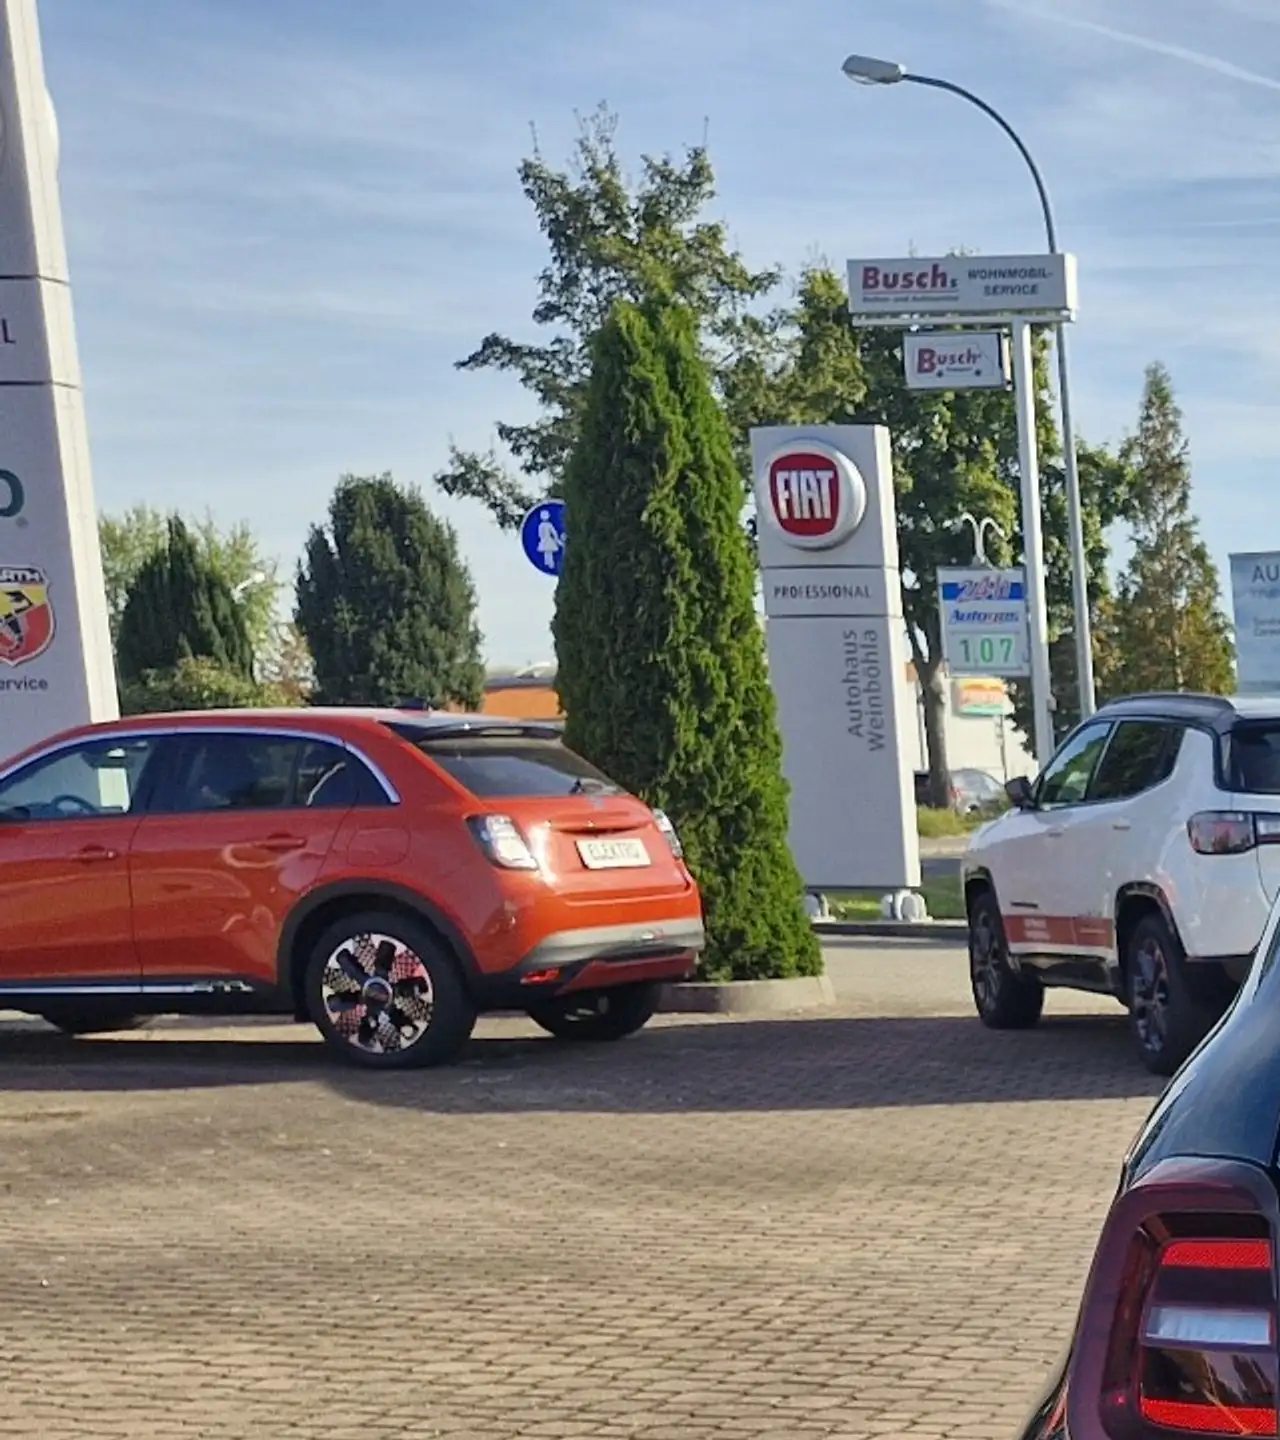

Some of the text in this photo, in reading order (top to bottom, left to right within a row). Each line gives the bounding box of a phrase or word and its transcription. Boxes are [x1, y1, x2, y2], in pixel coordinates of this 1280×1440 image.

[776, 470, 834, 520] FIAT
[774, 585, 871, 598] PROFESSIONAL
[842, 629, 864, 738] Autohaus
[860, 629, 886, 752] Weinböhla
